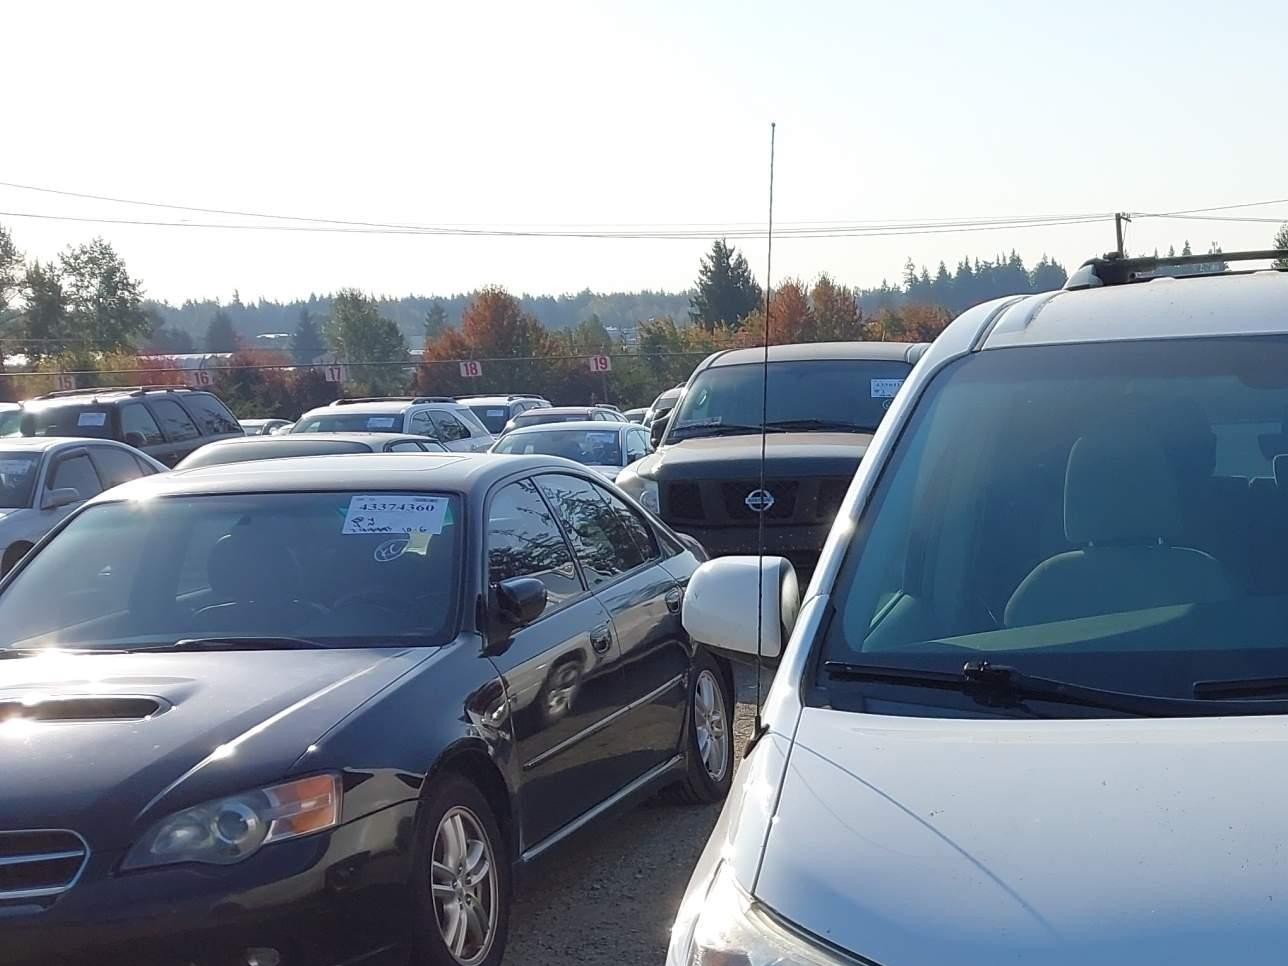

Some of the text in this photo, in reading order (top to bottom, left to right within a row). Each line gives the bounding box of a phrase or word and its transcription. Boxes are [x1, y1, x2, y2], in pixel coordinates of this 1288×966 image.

[464, 363, 478, 376] 18
[594, 357, 608, 370] 19
[194, 372, 209, 386] 16
[330, 367, 341, 381] 17
[58, 375, 72, 390] 15
[360, 503, 435, 512] 43374360
